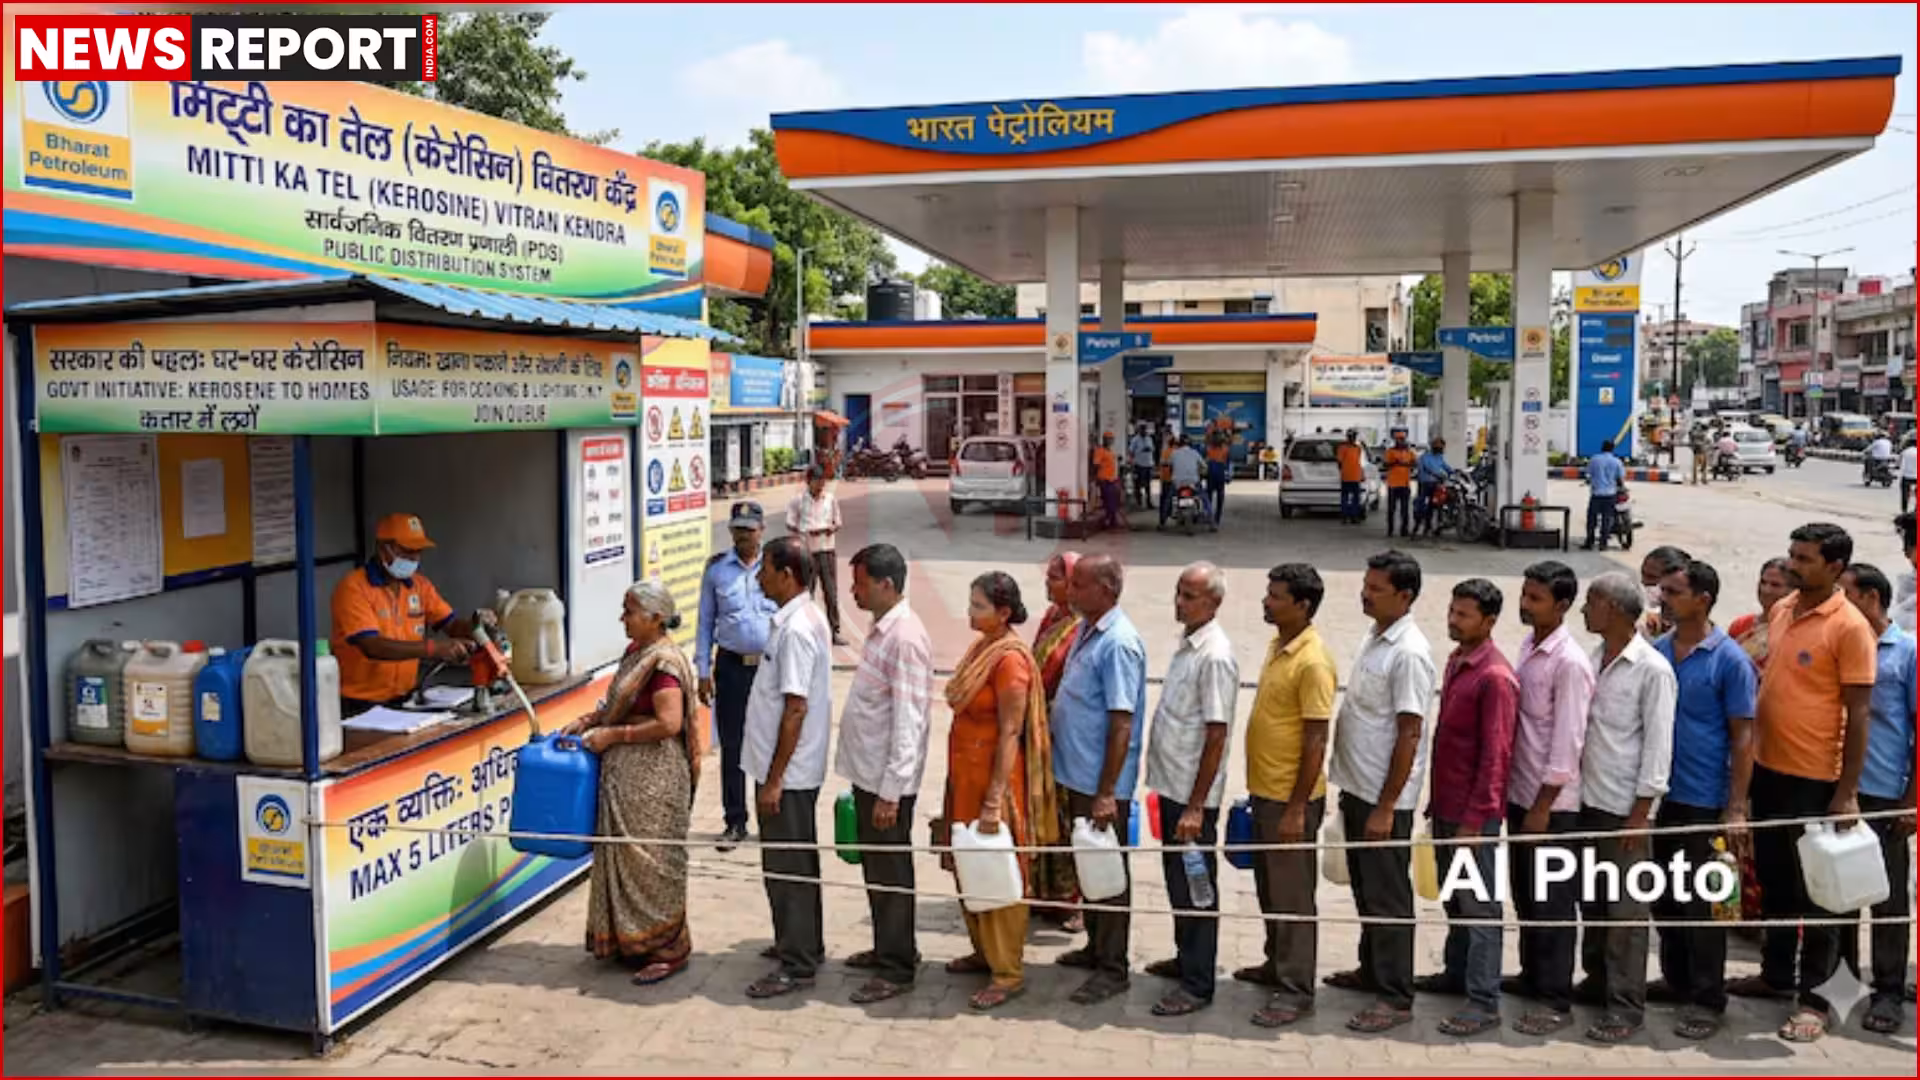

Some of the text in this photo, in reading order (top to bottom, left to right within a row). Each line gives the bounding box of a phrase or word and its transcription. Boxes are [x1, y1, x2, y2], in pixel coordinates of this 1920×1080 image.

[907, 101, 1115, 145] भारत पेट्रोलियम
[46, 132, 109, 158] Bharat
[283, 104, 330, 147] का
[338, 105, 393, 161] तेल
[403, 122, 523, 195] (केरोसिन)
[532, 151, 599, 202] वितरण
[29, 150, 128, 181] Petroleum
[187, 144, 627, 245] MITTI KA TEL (KEROSINE) VITRAN KENDRA
[304, 206, 564, 264] सार्वजनिक वितरण प्रणाली (PDS)
[323, 238, 552, 283] PUBLIC DISTRIBUTION SYSTEM
[1086, 336, 1121, 348] Petrol
[1468, 331, 1504, 343] Petrol
[49, 349, 114, 371] सरकार
[118, 339, 145, 370] की
[212, 349, 278, 371] घर-घर
[282, 339, 364, 371] केरोसिन
[47, 381, 369, 400] GOVT INITIATIVE: KEROSENE TO HOMES
[140, 409, 193, 429] कतार
[198, 404, 217, 429] में
[474, 404, 504, 423] JOIN
[348, 804, 389, 853] एक
[350, 848, 402, 900] MAX
[409, 839, 421, 870] 5
[429, 804, 494, 862] LITERS
